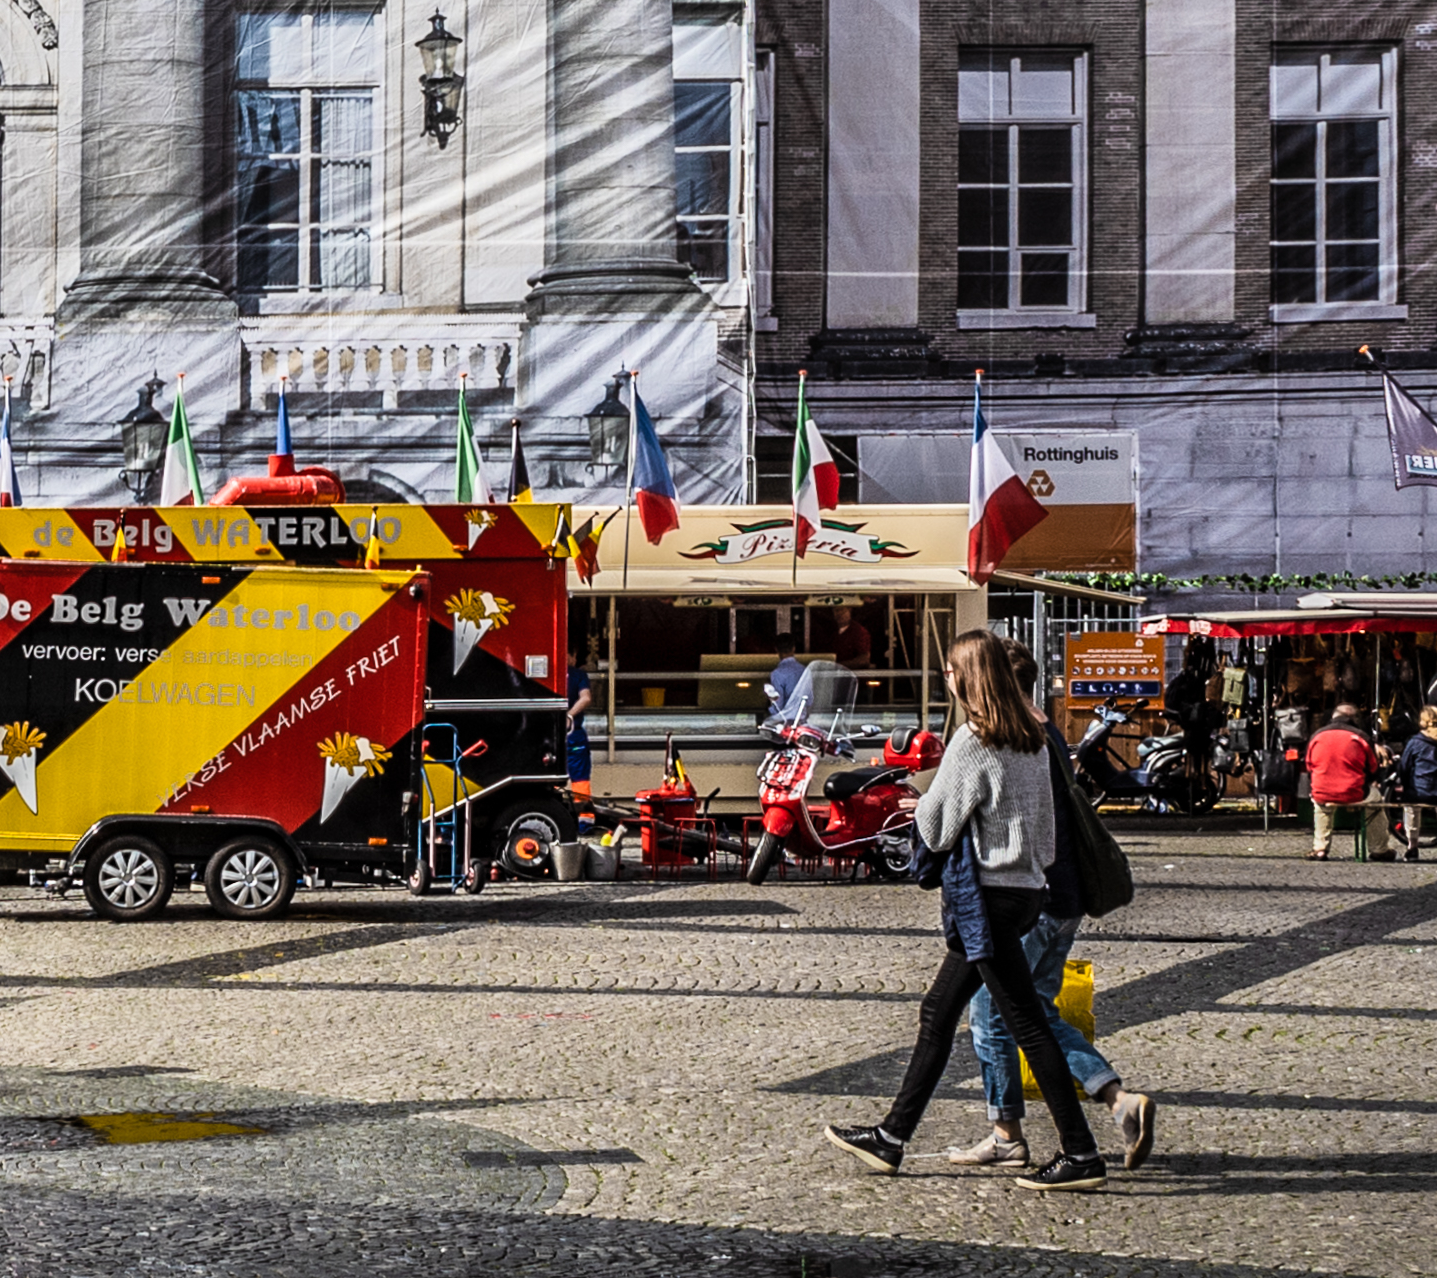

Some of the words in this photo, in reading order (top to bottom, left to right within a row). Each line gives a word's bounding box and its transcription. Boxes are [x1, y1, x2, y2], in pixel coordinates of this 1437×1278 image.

[1023, 446, 1119, 464] Rottinghuis
[33, 520, 74, 547] de
[92, 518, 173, 554] Belg
[191, 516, 402, 549] WATERLOO
[50, 594, 145, 631] Belg
[163, 597, 361, 632] Waterloo
[22, 644, 106, 662] vervoer:
[115, 646, 172, 664] verse
[182, 648, 314, 668] aardappelen
[75, 677, 255, 707] KOELWAGEN
[156, 751, 232, 808] VERSE
[232, 678, 342, 757] VLAAMSE
[345, 635, 401, 686] FRIET
